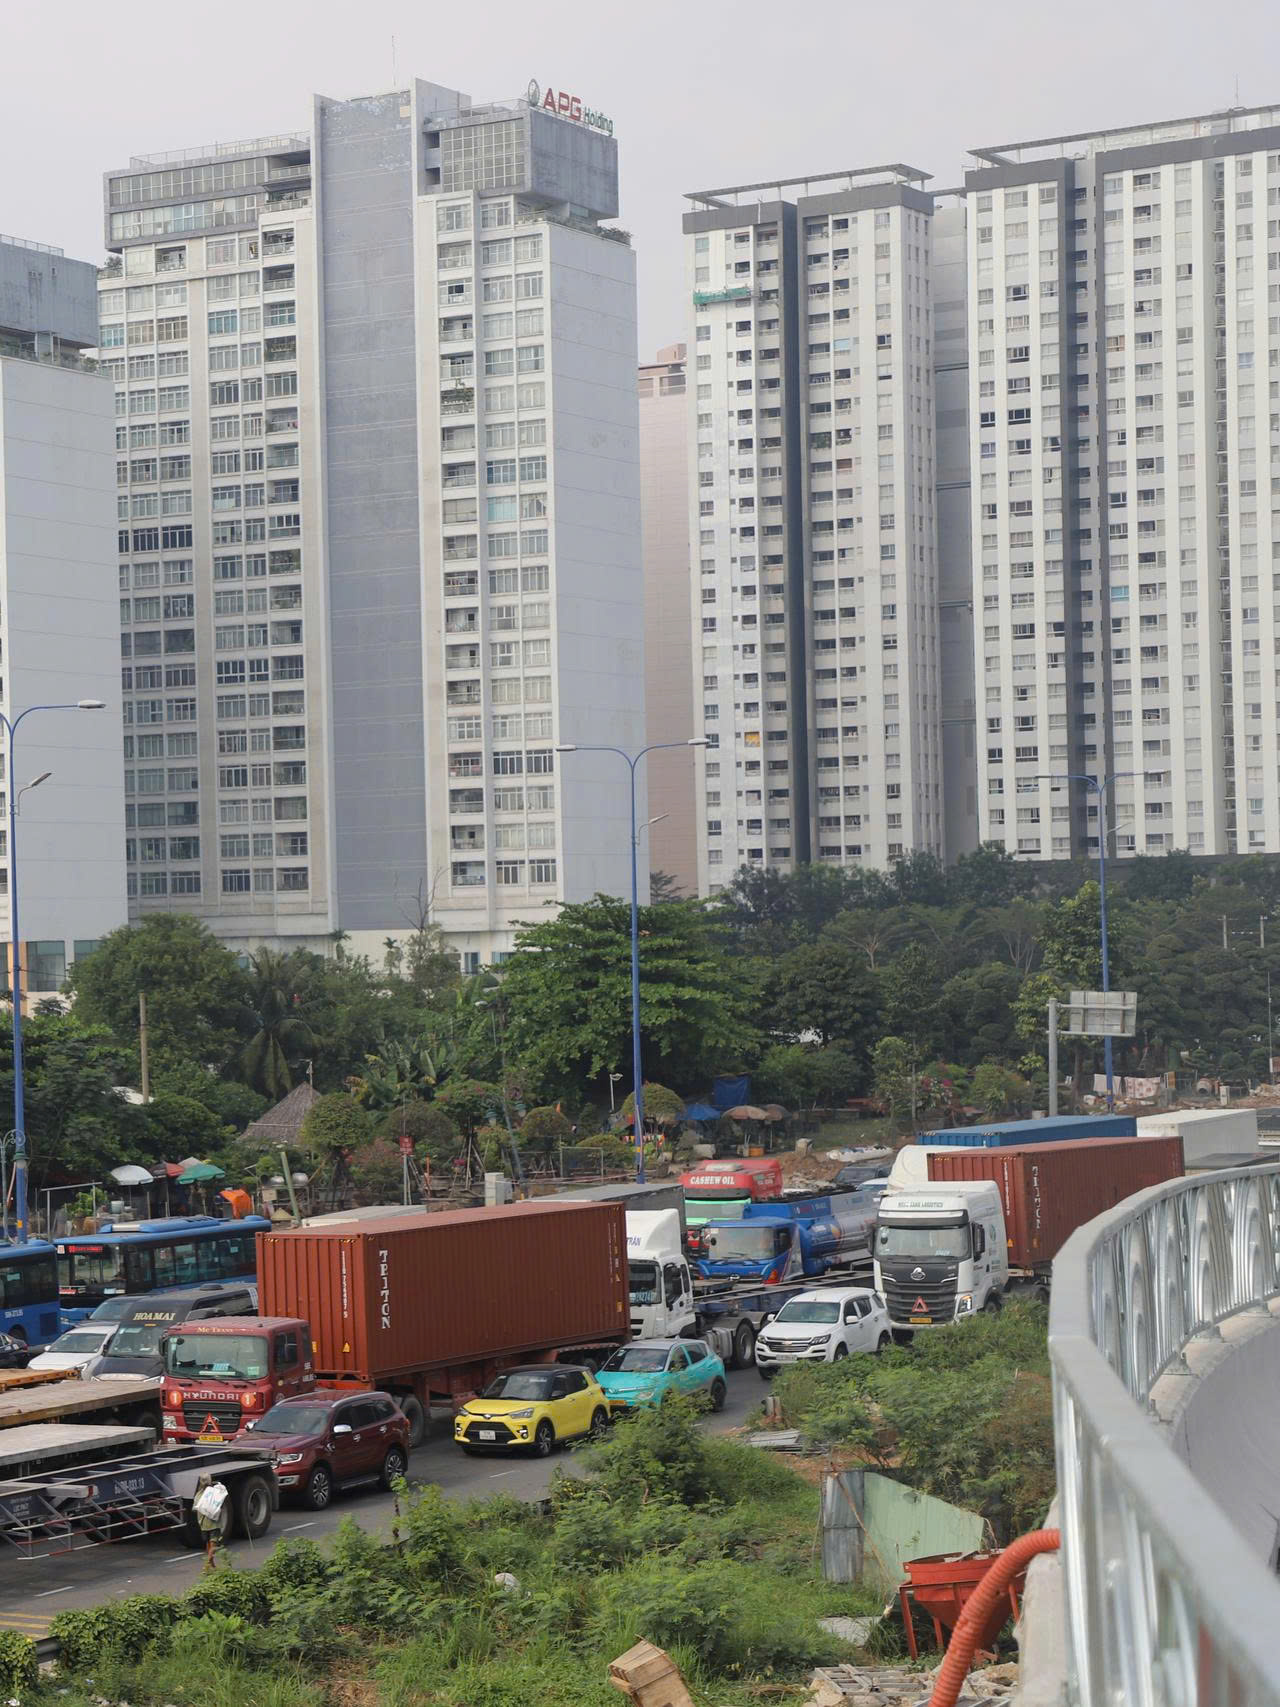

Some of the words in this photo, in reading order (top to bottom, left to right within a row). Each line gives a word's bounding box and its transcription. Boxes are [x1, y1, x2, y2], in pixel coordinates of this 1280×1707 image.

[543, 87, 582, 122] APG
[583, 105, 614, 138] Holding
[689, 1175, 721, 1185] CASHEW
[722, 1175, 735, 1185] OIL
[379, 1249, 391, 1329] TRITON
[183, 1391, 240, 1401] HYUNDAI
